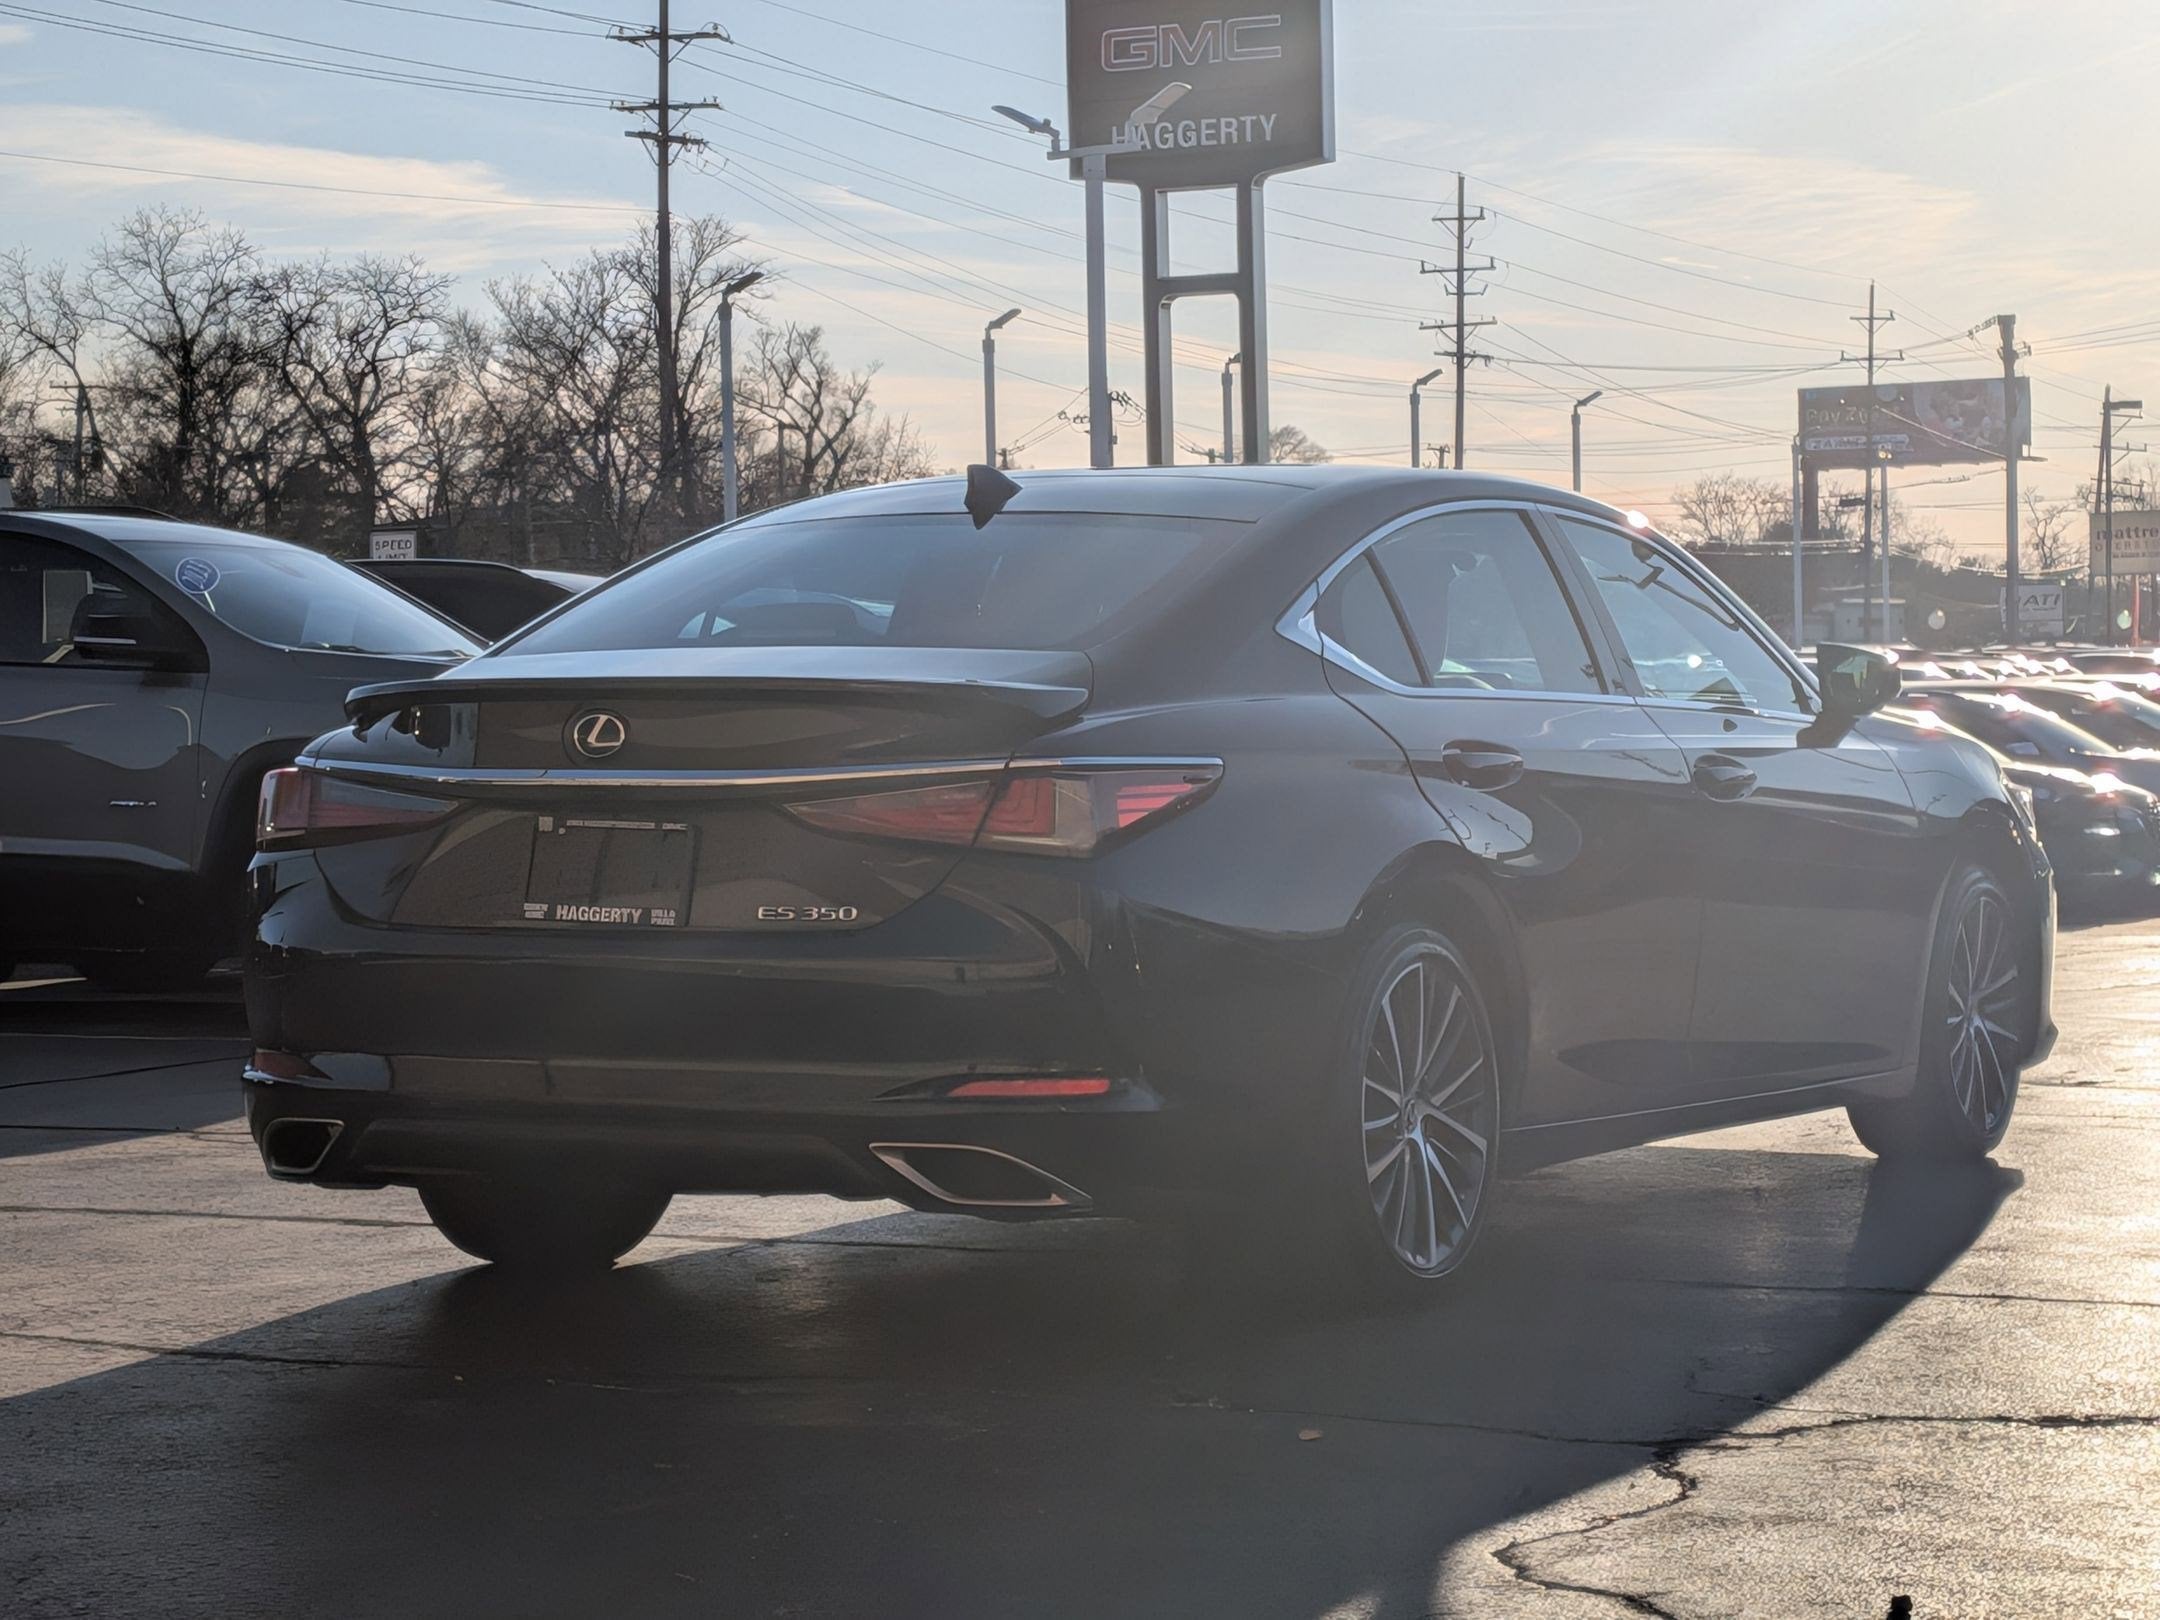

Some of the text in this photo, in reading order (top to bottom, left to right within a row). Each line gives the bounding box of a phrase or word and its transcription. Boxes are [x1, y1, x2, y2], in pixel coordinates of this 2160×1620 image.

[1101, 15, 1281, 72] GMC
[1111, 114, 1277, 150] HAGGERTY
[375, 539, 412, 550] SPEED
[556, 904, 642, 924] HAGGERTY
[758, 906, 858, 921] ES 350
